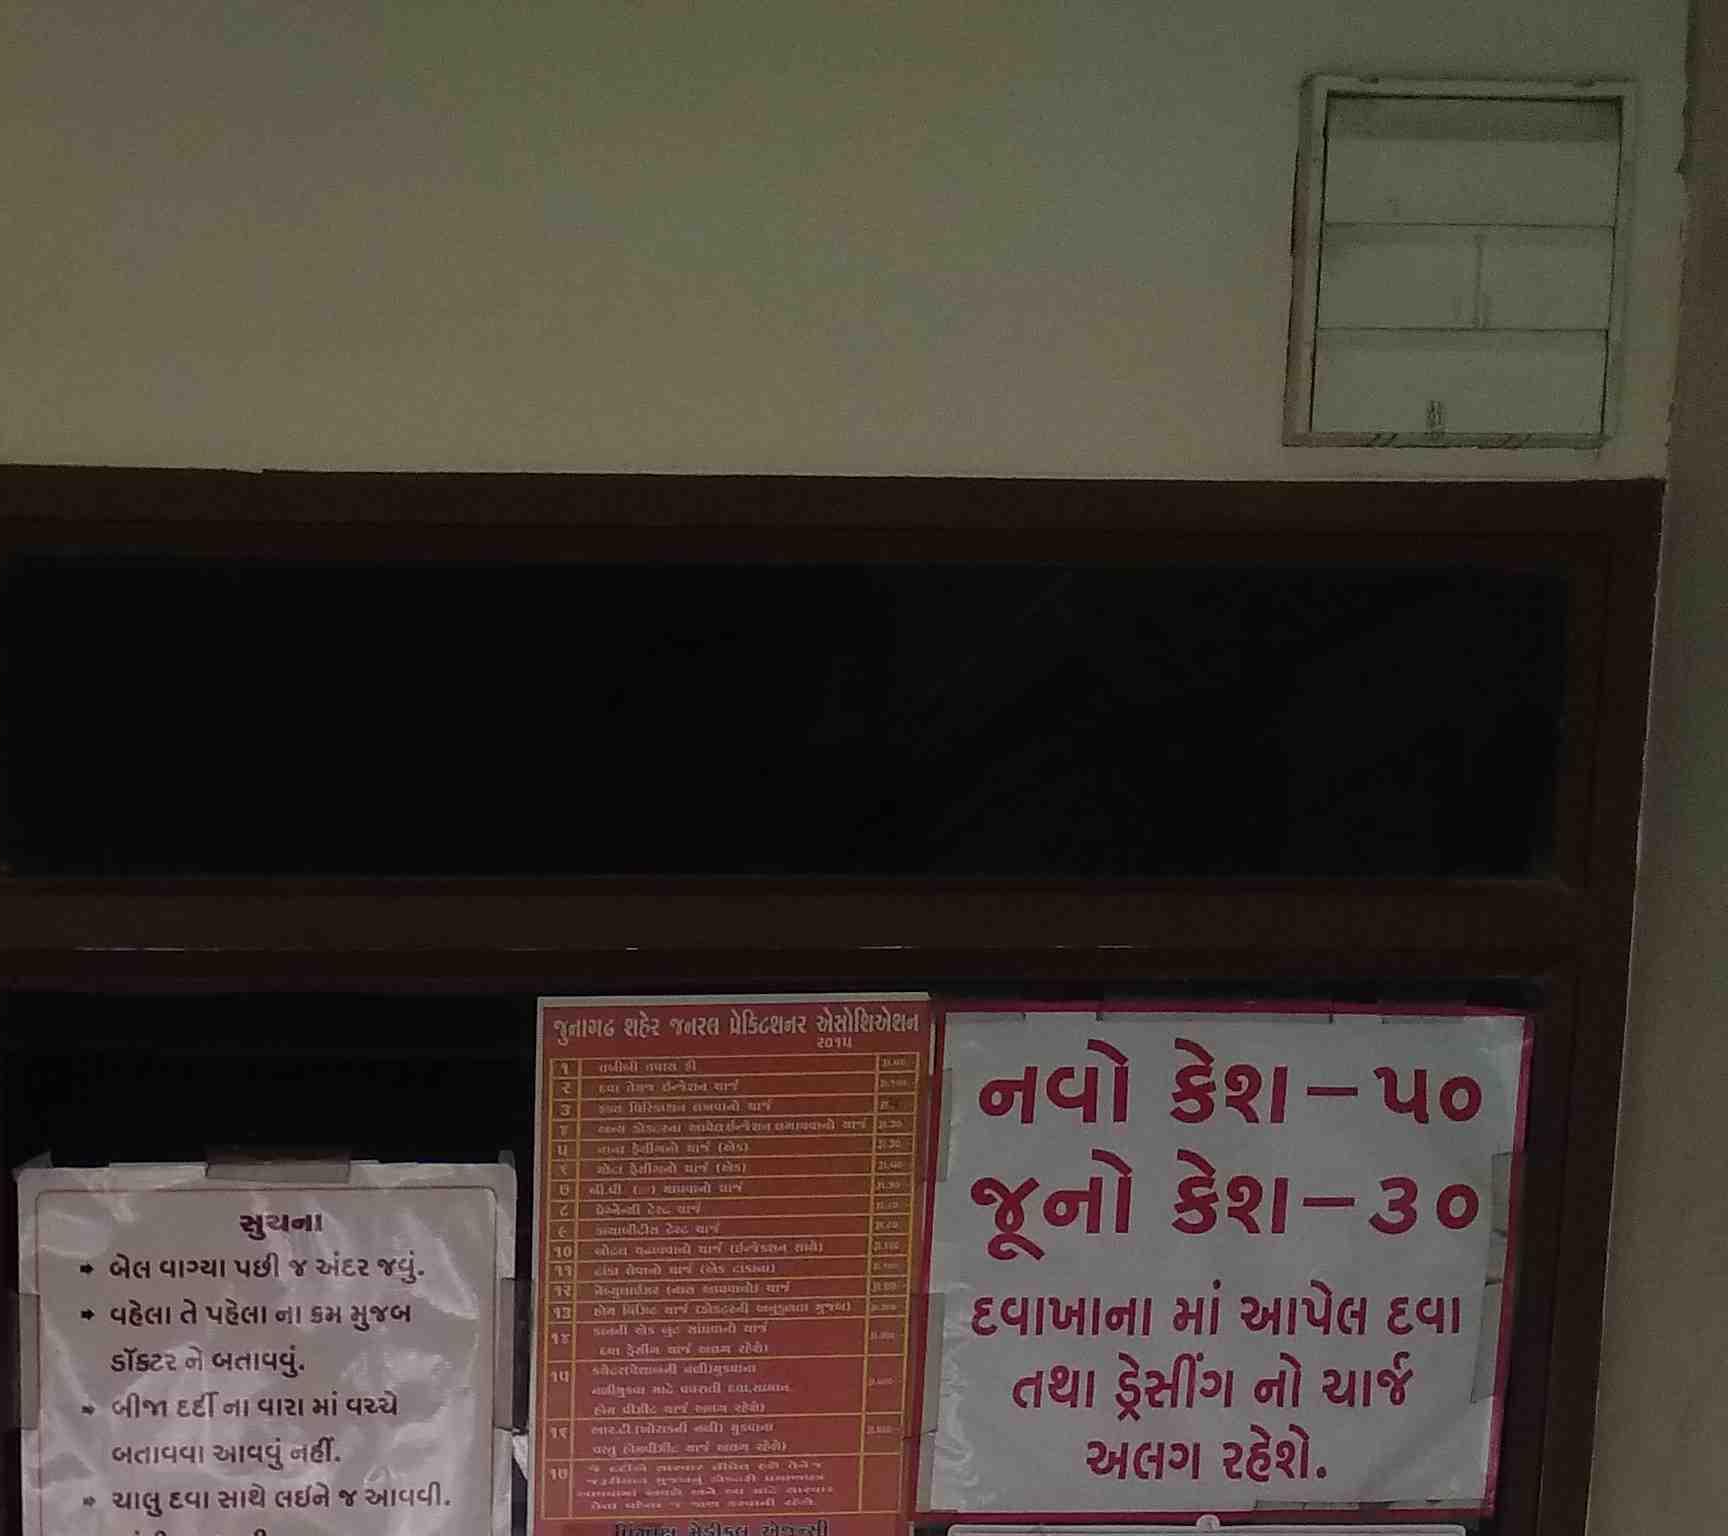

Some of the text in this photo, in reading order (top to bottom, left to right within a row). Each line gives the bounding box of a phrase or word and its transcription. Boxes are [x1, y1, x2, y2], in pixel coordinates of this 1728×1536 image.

[978, 1038, 1130, 1125] નવો
[970, 1149, 1132, 1261] જૂનો
[109, 1254, 151, 1279] બેલ
[233, 1252, 279, 1279] પછી
[288, 1259, 308, 1279] જ
[315, 1253, 369, 1278] અંદર
[110, 1298, 171, 1327] વહેલા
[180, 1296, 197, 1325] તે
[205, 1297, 268, 1327] પહેલા
[275, 1305, 302, 1325] ના
[350, 1303, 411, 1331] મુજબ
[971, 1279, 1461, 1338] દવાખાના માં આપેલ દવા
[185, 1346, 203, 1373] ને
[1012, 1364, 1093, 1409] તથા
[1253, 1352, 1301, 1408] નો
[1322, 1351, 1414, 1408] ચાર્જ
[111, 1393, 168, 1418] બીજા
[222, 1396, 250, 1418] ના
[257, 1395, 304, 1417] વારા
[312, 1392, 338, 1416] માં
[111, 1442, 205, 1466] બતાવવા
[1086, 1436, 1200, 1480] અલગ
[169, 1489, 209, 1510] દવા
[217, 1482, 266, 1509] સાથે
[338, 1488, 356, 1509] જ
